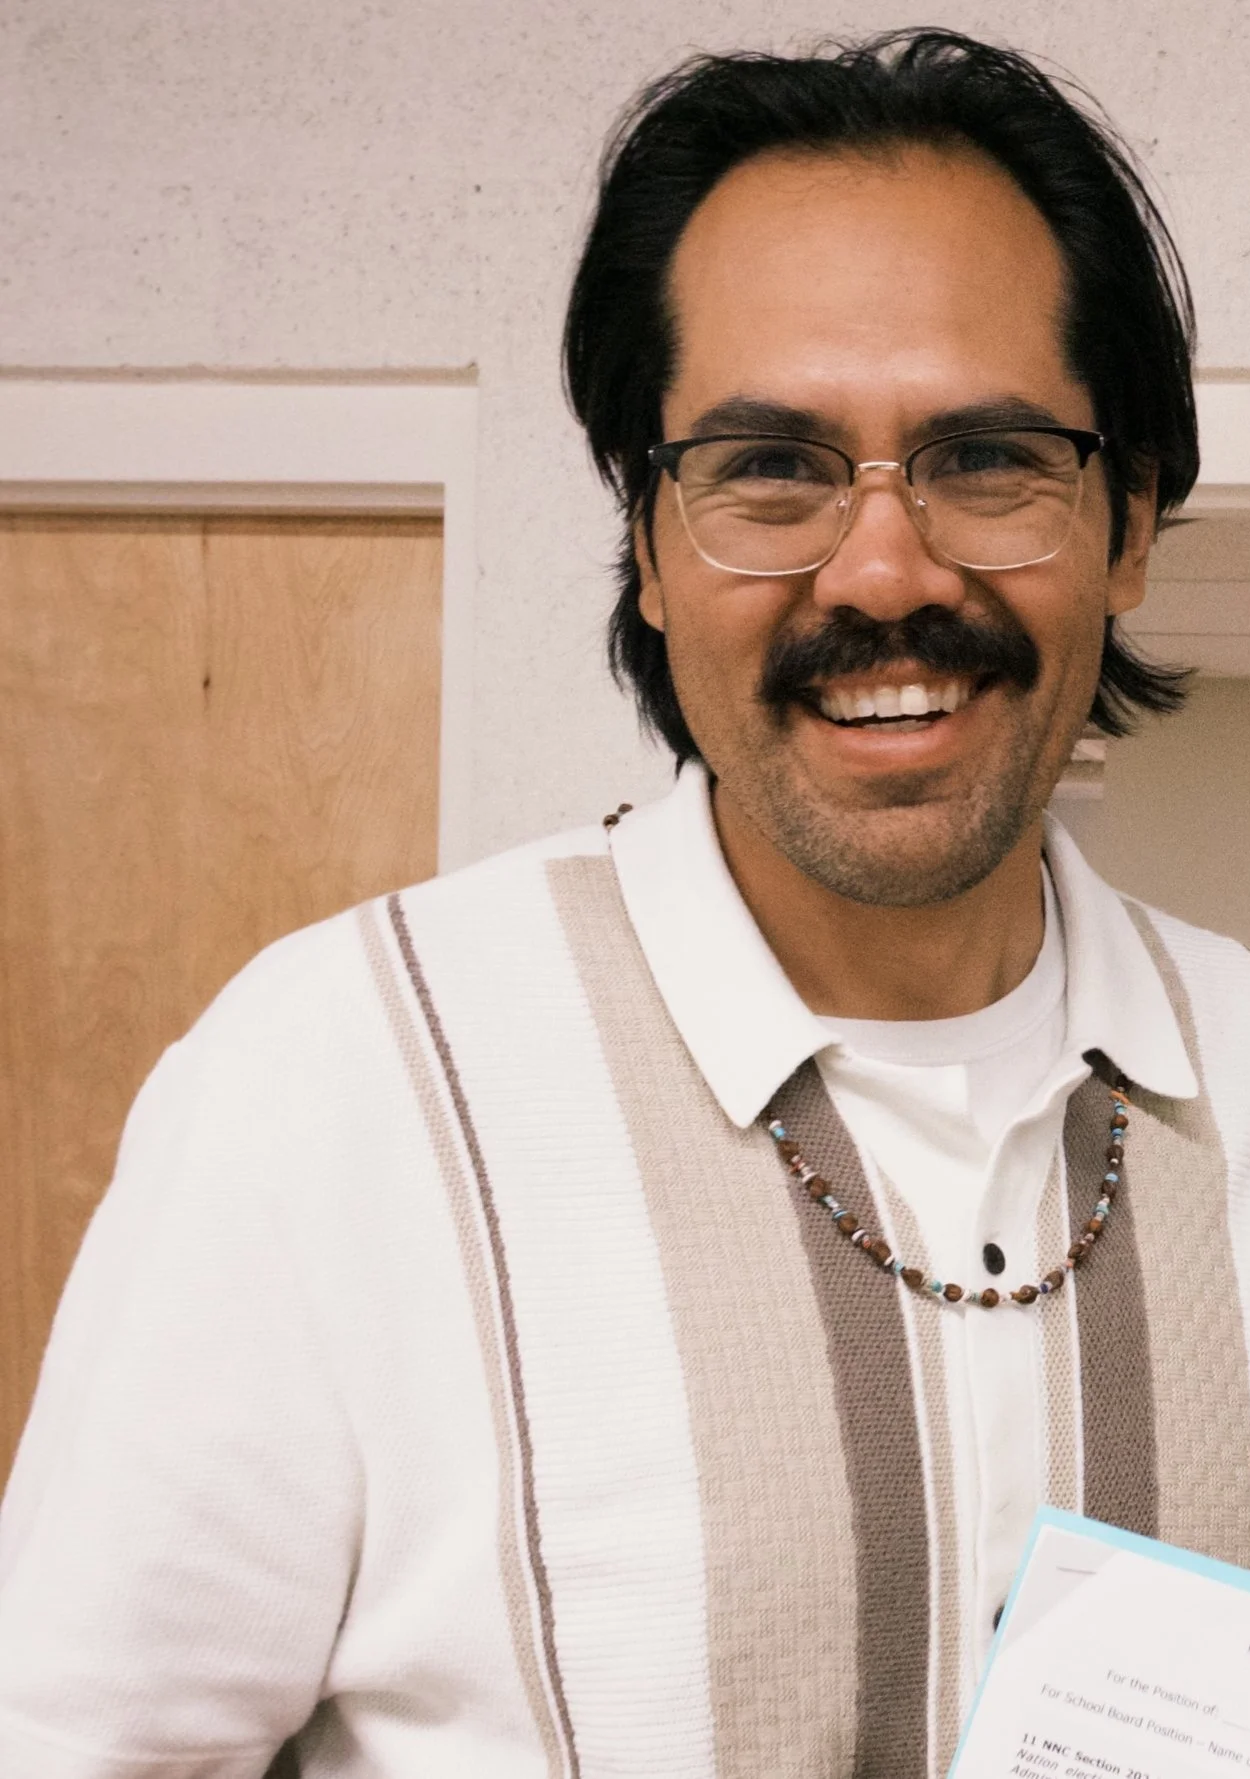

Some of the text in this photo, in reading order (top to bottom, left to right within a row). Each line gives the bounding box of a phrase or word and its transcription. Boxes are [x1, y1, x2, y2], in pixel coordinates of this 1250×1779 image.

[1106, 1669, 1127, 1685] For
[1130, 1676, 1149, 1693] the
[1152, 1684, 1199, 1711] Position
[1040, 1683, 1062, 1699] For
[1064, 1691, 1104, 1715] School
[1107, 1705, 1144, 1729] Board
[1146, 1719, 1193, 1746] Position
[1207, 1740, 1244, 1763] Name
[1016, 1748, 1059, 1771] Nation
[1022, 1733, 1037, 1746] 11
[1042, 1739, 1071, 1757] NNC
[1074, 1751, 1121, 1776] Section
